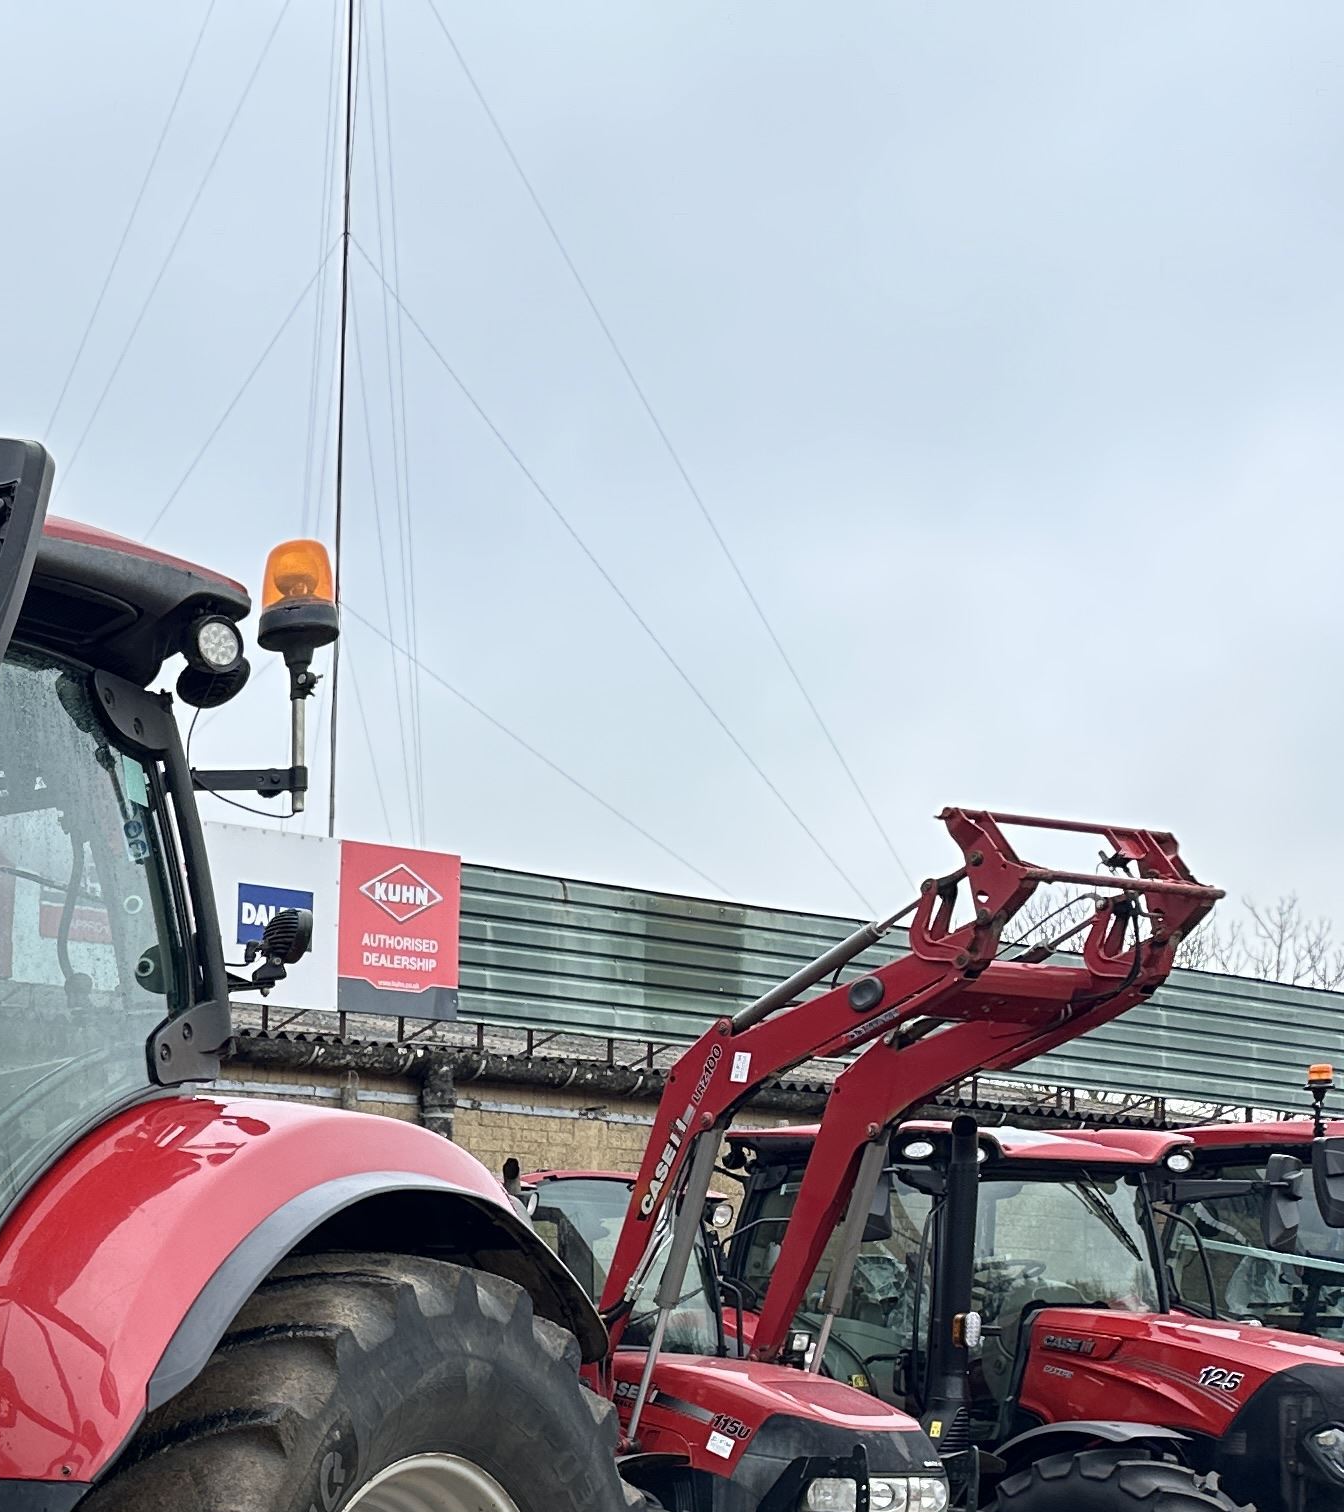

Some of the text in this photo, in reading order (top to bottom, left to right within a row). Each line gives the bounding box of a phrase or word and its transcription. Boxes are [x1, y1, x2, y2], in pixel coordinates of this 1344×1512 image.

[374, 881, 430, 906] KUHN
[361, 932, 439, 954] AUTHORISED
[362, 951, 438, 973] DEALERSHIP
[640, 1144, 679, 1216] CASE
[1043, 1334, 1081, 1352] CASE
[1198, 1366, 1244, 1392] 125
[713, 1413, 752, 1441] 115U
